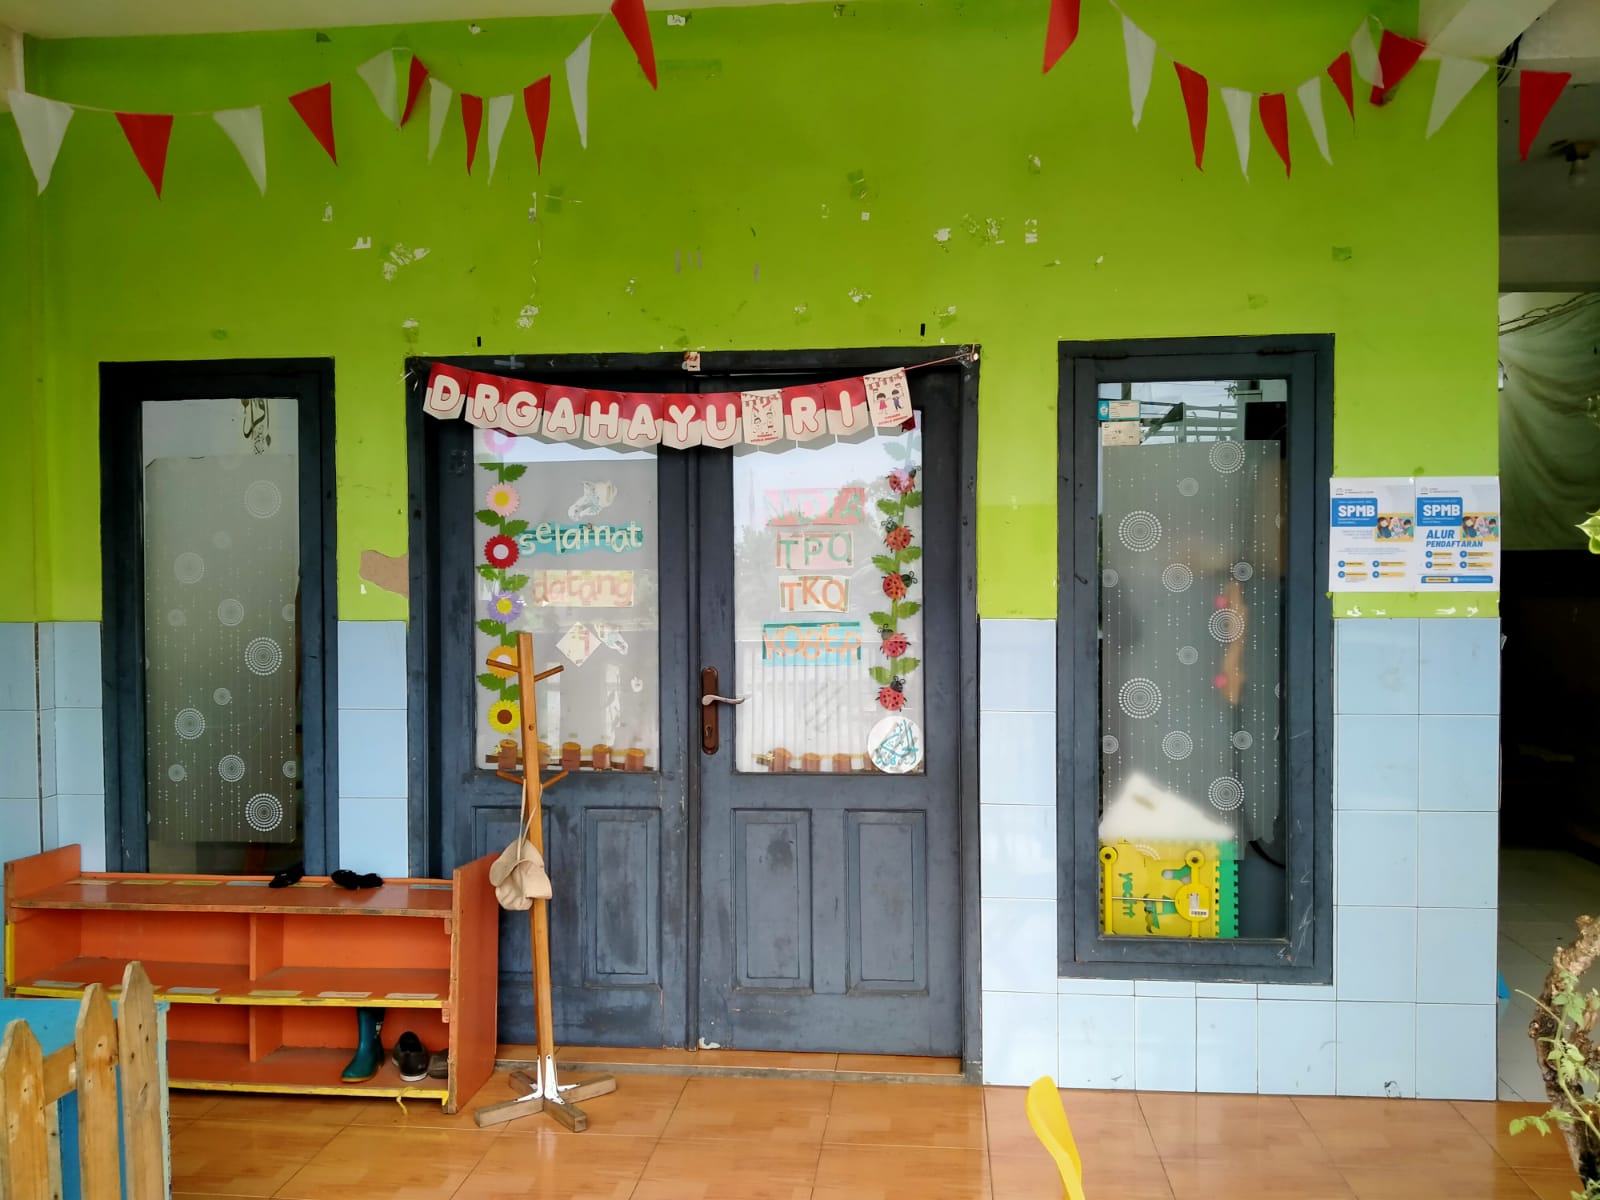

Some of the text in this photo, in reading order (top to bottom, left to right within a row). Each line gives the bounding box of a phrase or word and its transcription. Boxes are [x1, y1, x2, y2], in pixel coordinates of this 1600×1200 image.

[429, 374, 857, 448] DRGAHAYU RI
[1338, 504, 1375, 517] SPMB
[1423, 504, 1461, 517] SPMB
[520, 520, 642, 555] selamat
[1426, 529, 1455, 539] ALUR
[1426, 540, 1484, 548] PENDAFTARAN
[532, 570, 633, 607] datang
